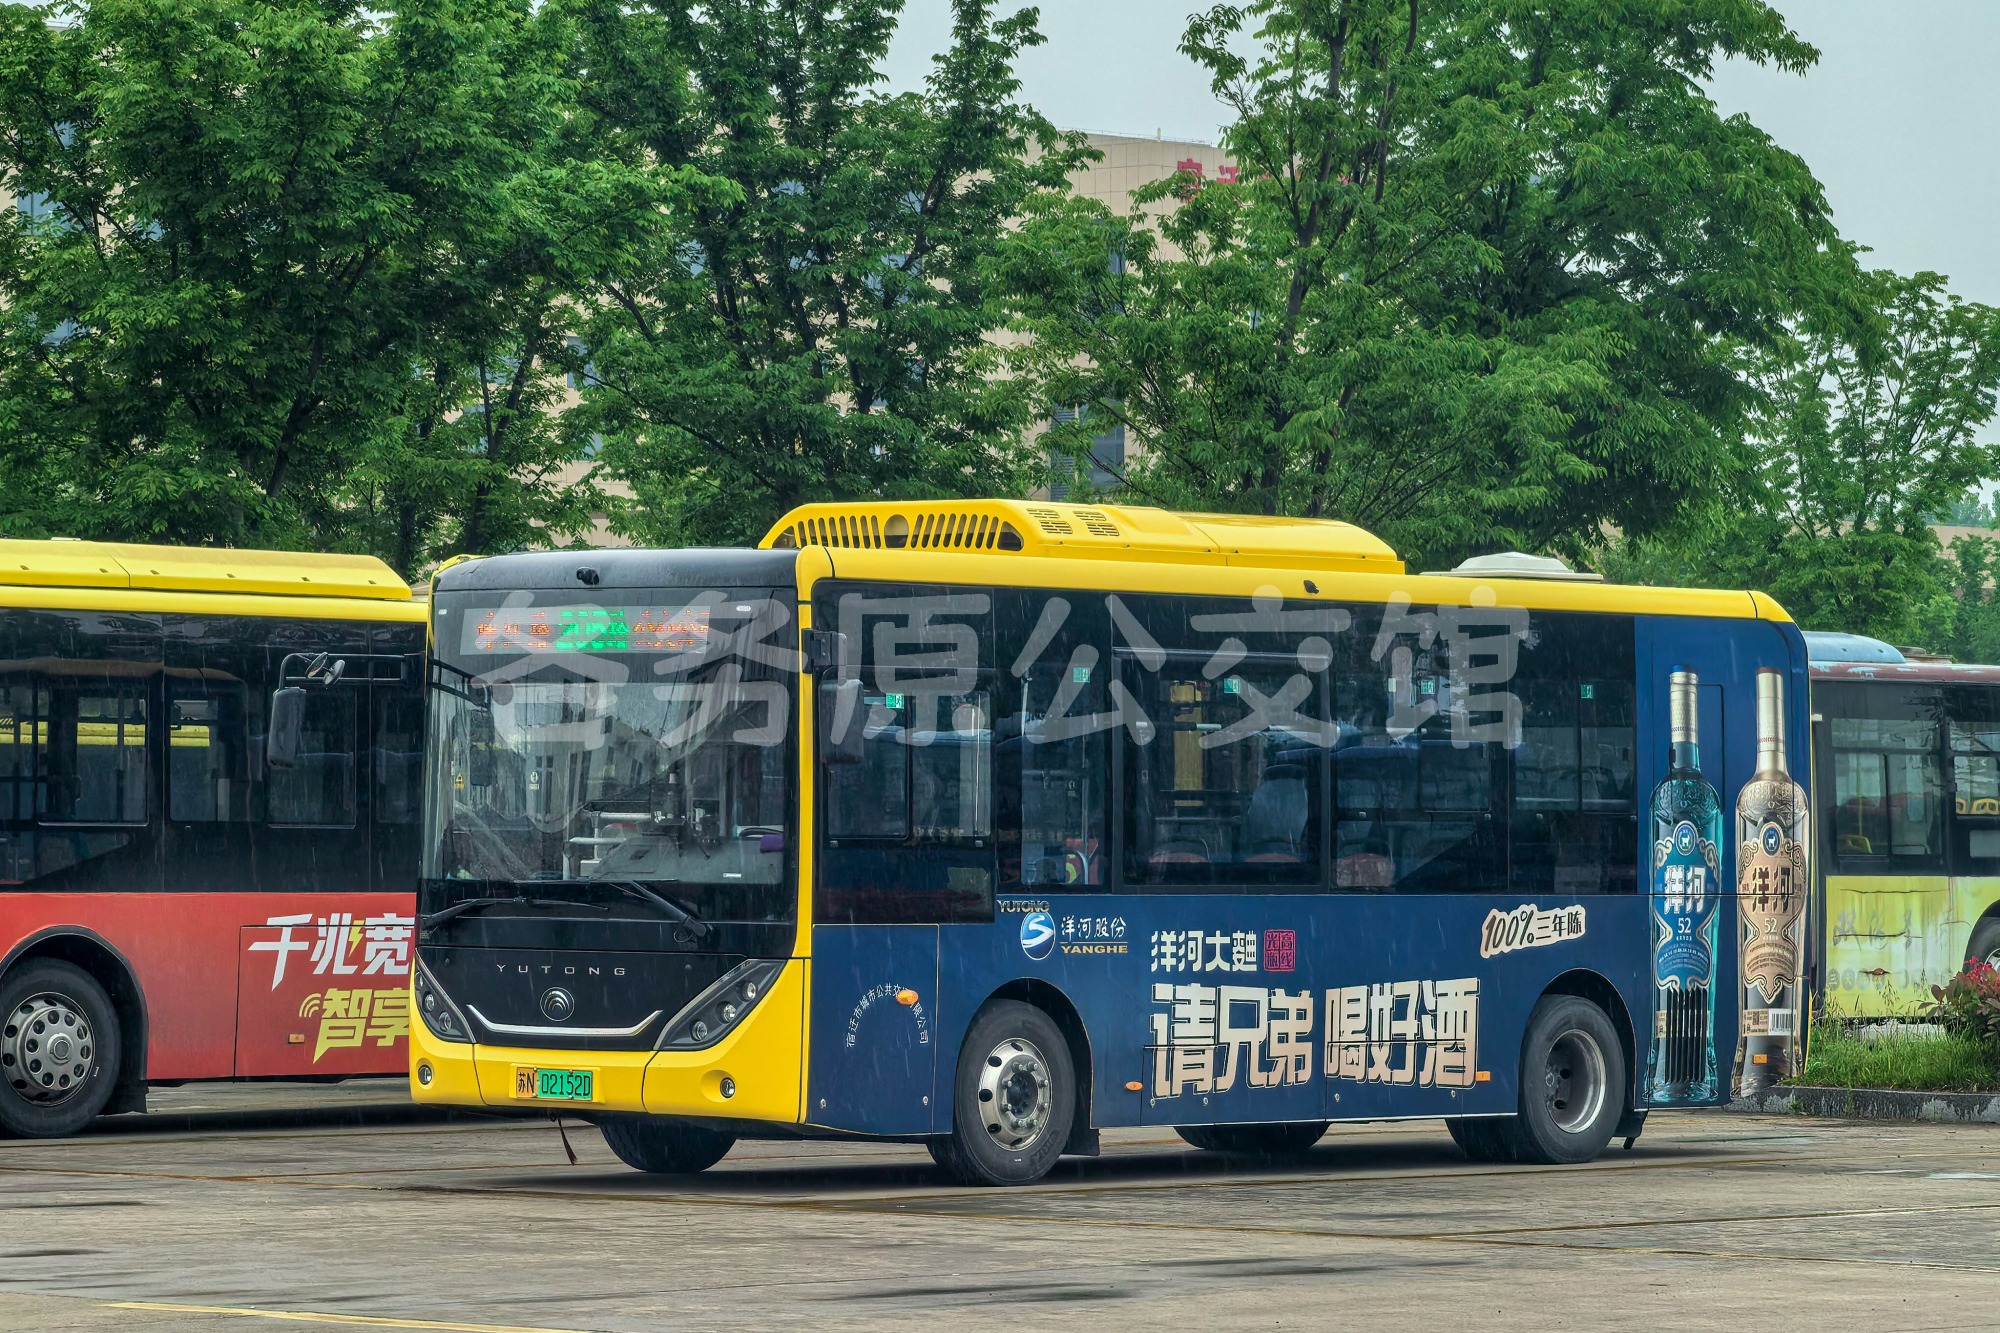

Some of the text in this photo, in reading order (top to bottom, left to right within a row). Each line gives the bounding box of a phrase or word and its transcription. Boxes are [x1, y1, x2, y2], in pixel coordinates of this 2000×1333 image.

[1061, 914, 1127, 942] 洋河股份
[1677, 917, 1692, 934] 52
[1764, 917, 1777, 933] 52
[1061, 945, 1128, 954] YANGHE
[496, 963, 625, 976] YUTONG
[845, 982, 929, 1048] 宿迁市城市公共交限公司
[1150, 977, 1480, 1099] 请兄弟 喝好酒
